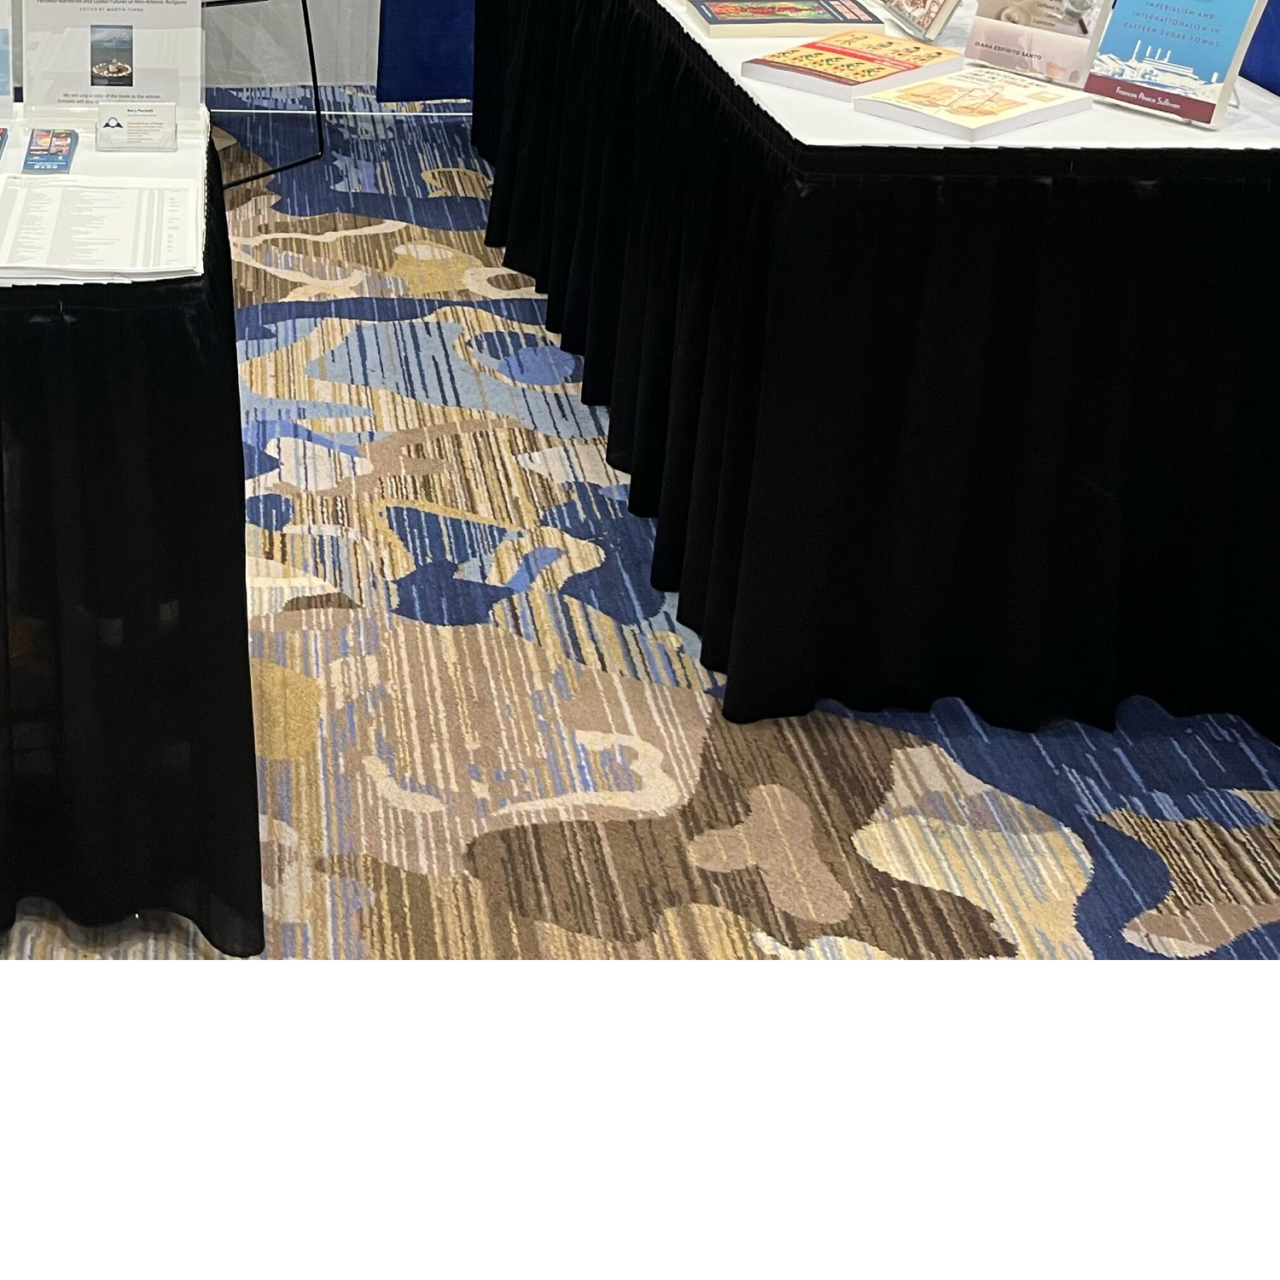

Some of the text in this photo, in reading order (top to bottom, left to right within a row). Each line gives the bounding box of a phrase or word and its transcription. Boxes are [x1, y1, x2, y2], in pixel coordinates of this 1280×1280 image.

[1146, 1, 1215, 20] IMPERIALISM AND
[1021, 51, 1042, 60] SANTO
